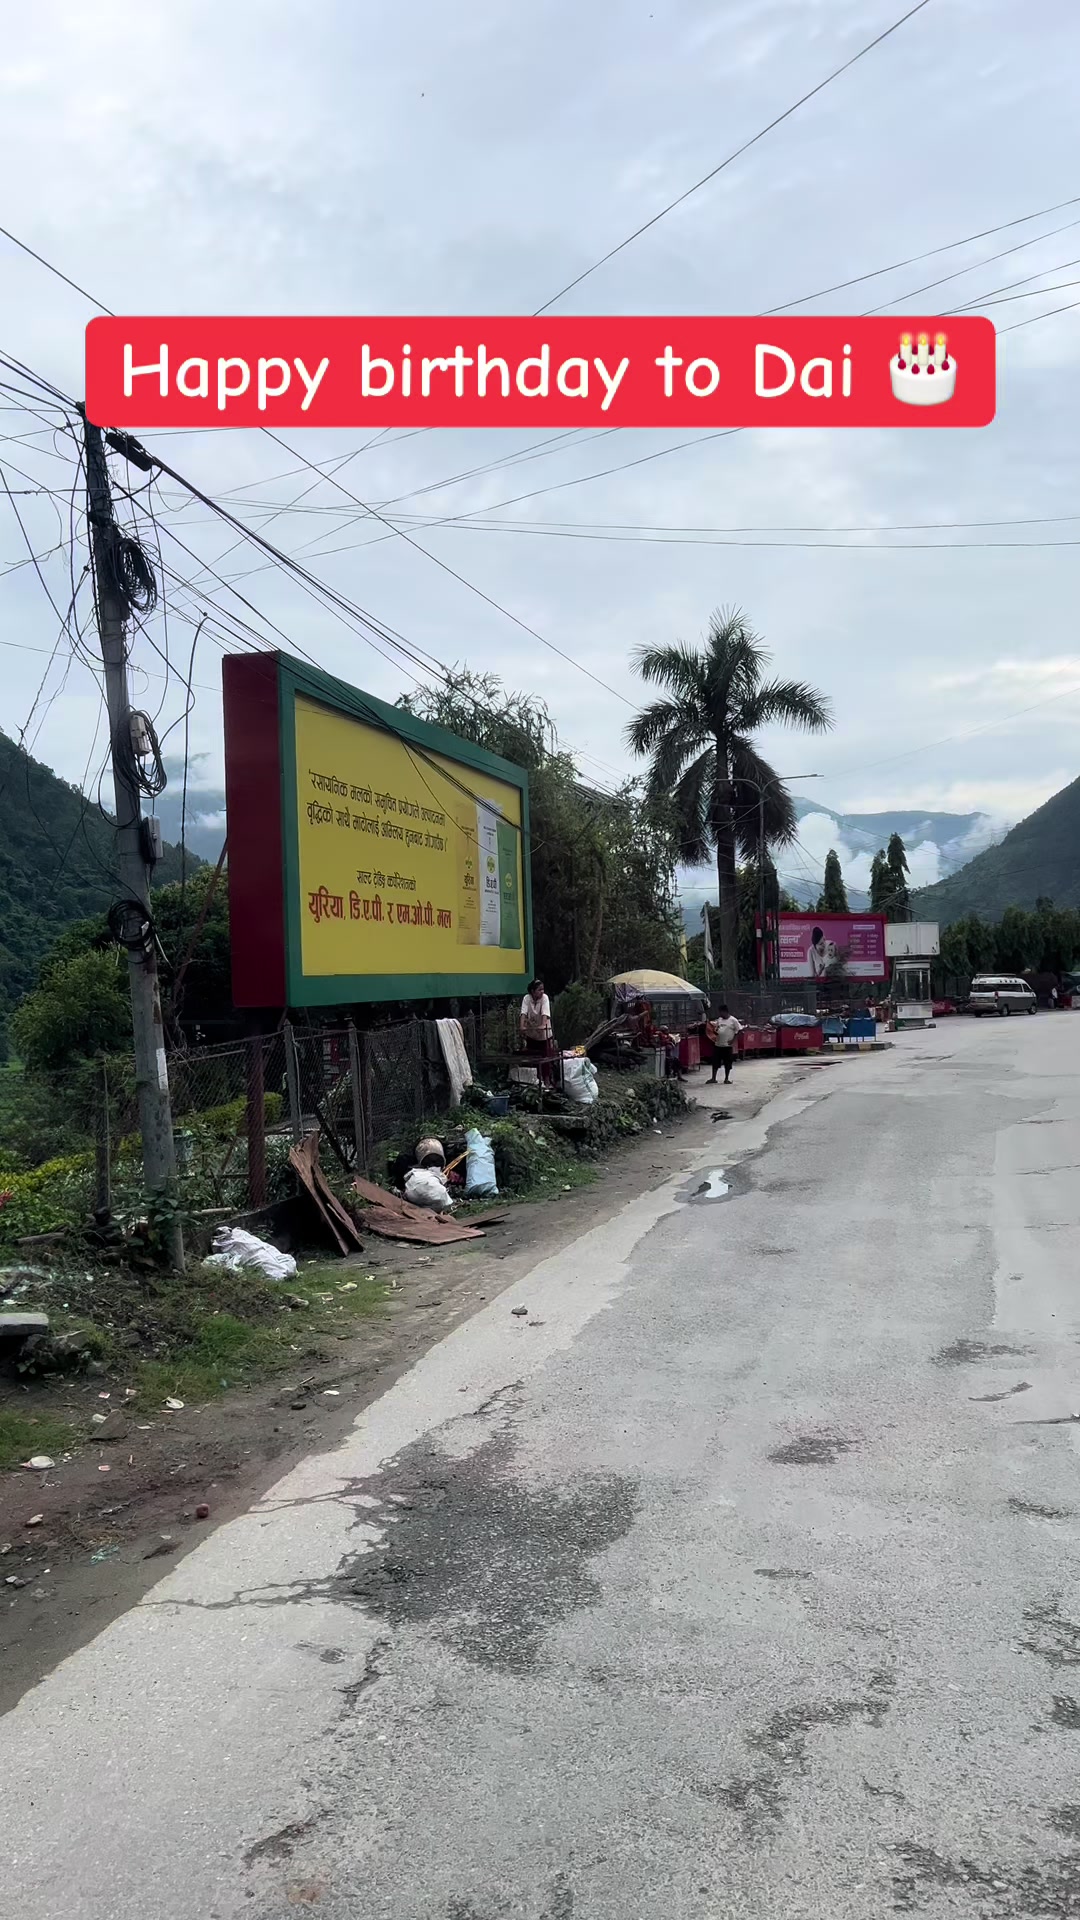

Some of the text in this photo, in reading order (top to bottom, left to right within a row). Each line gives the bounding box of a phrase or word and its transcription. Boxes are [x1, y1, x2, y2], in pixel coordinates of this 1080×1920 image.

[350, 784, 373, 805] मलको
[306, 800, 334, 825] वृद्धिको
[335, 806, 351, 829] साथै
[356, 870, 372, 885] साल्ट
[308, 885, 346, 923] युरिया,
[387, 902, 394, 924] र
[437, 908, 452, 929] मल
